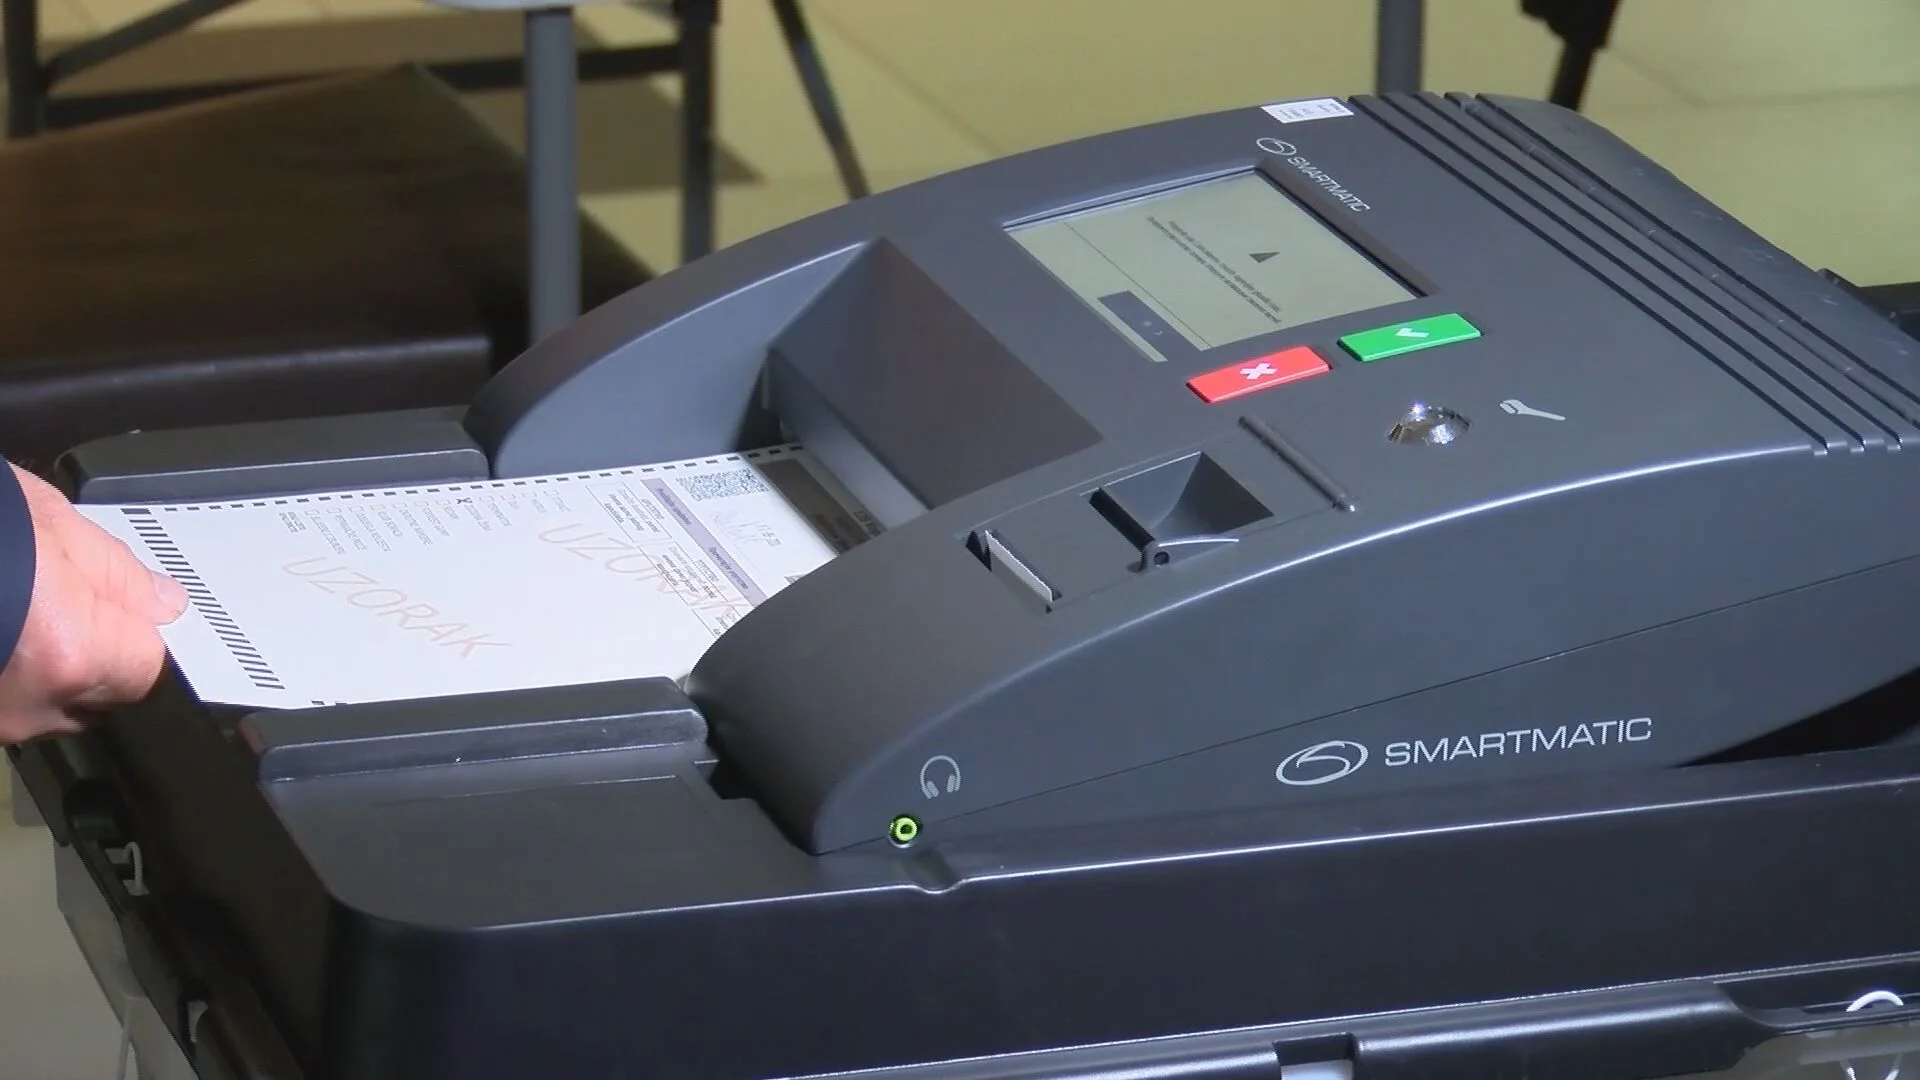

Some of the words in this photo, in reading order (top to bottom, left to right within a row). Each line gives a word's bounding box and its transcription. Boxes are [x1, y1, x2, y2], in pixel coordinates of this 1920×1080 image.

[1287, 156, 1371, 213] SMARTMATIC
[282, 556, 513, 658] UZORAK
[1384, 716, 1653, 767] SMARTMATIC
